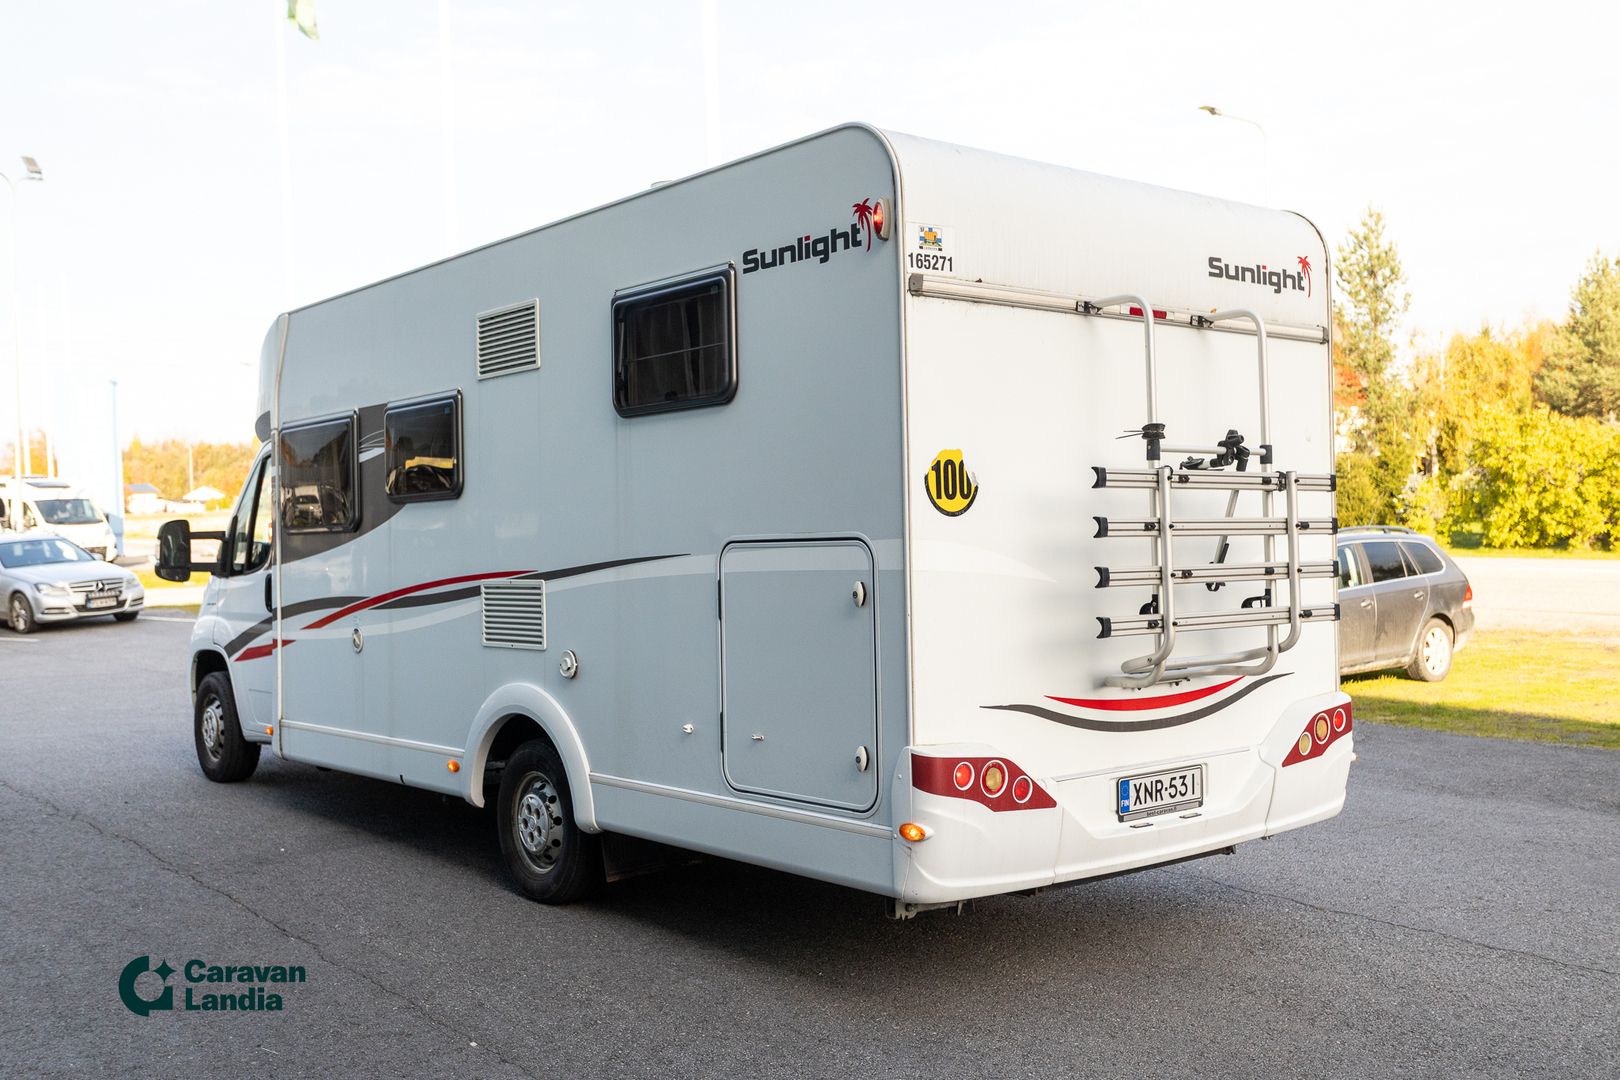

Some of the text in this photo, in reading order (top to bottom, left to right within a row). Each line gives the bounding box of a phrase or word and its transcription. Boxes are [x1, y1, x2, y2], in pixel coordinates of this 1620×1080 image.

[742, 222, 863, 275] Sunlight
[908, 252, 953, 272] 165271
[1208, 256, 1305, 294] Sunlight
[1133, 773, 1195, 806] XNR-531
